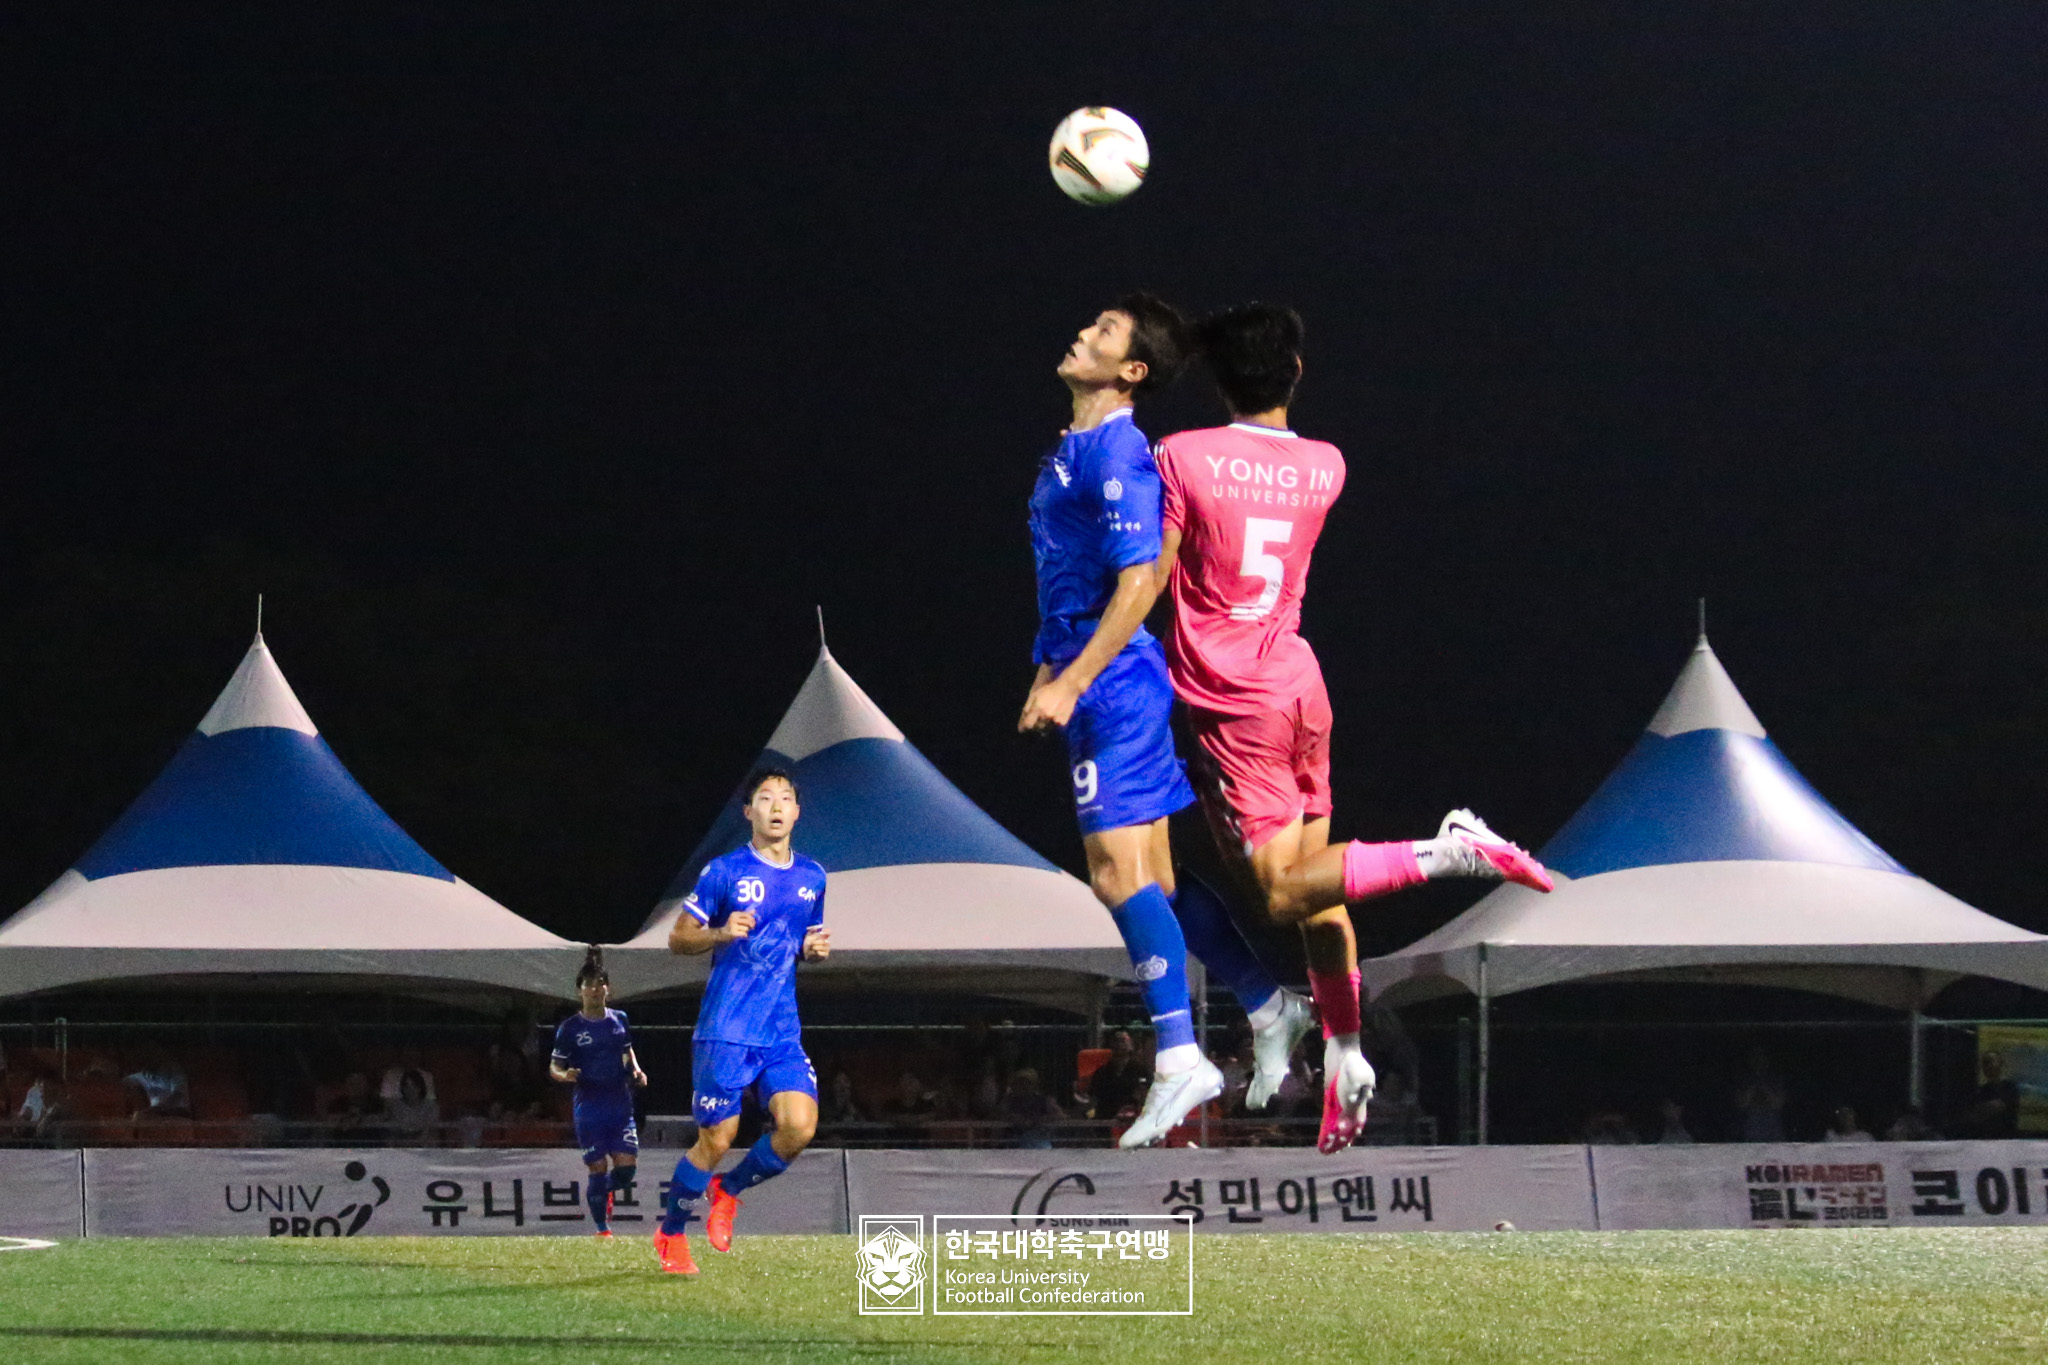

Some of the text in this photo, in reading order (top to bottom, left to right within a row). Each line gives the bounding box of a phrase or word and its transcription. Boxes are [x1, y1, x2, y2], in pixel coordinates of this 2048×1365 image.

[1205, 455, 1334, 491] YONG IN
[1212, 484, 1328, 508] UNIVERSITY
[1231, 516, 1294, 619] 5
[1073, 759, 1098, 805] 9
[737, 880, 765, 902] 30
[576, 1031, 592, 1047] 25
[225, 1185, 324, 1212] UNIV
[1162, 1175, 1433, 1224] 성민이엔씨
[1911, 1166, 2048, 1216] 코이
[269, 1216, 341, 1236] PRO
